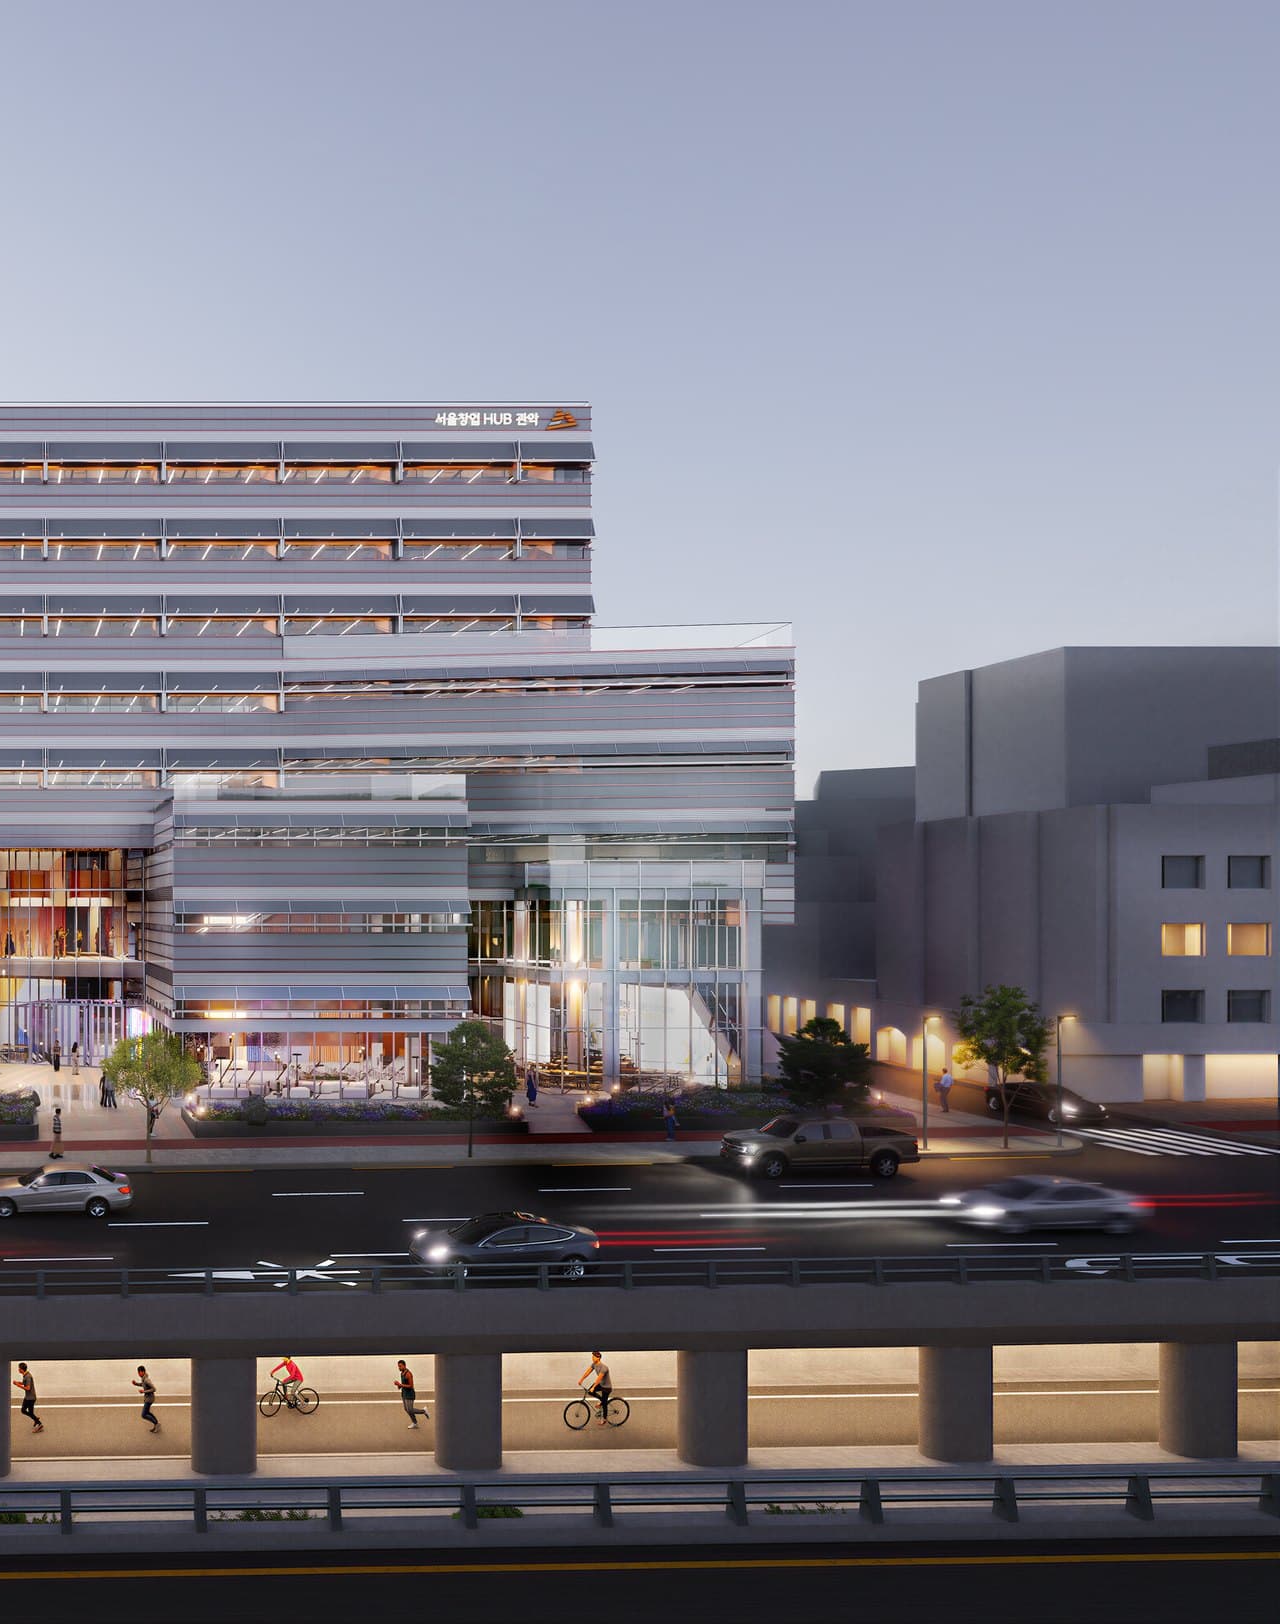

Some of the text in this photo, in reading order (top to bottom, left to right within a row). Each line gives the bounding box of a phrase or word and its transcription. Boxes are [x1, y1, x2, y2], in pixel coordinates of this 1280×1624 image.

[435, 412, 539, 426] 서울창업 HUB 관악
